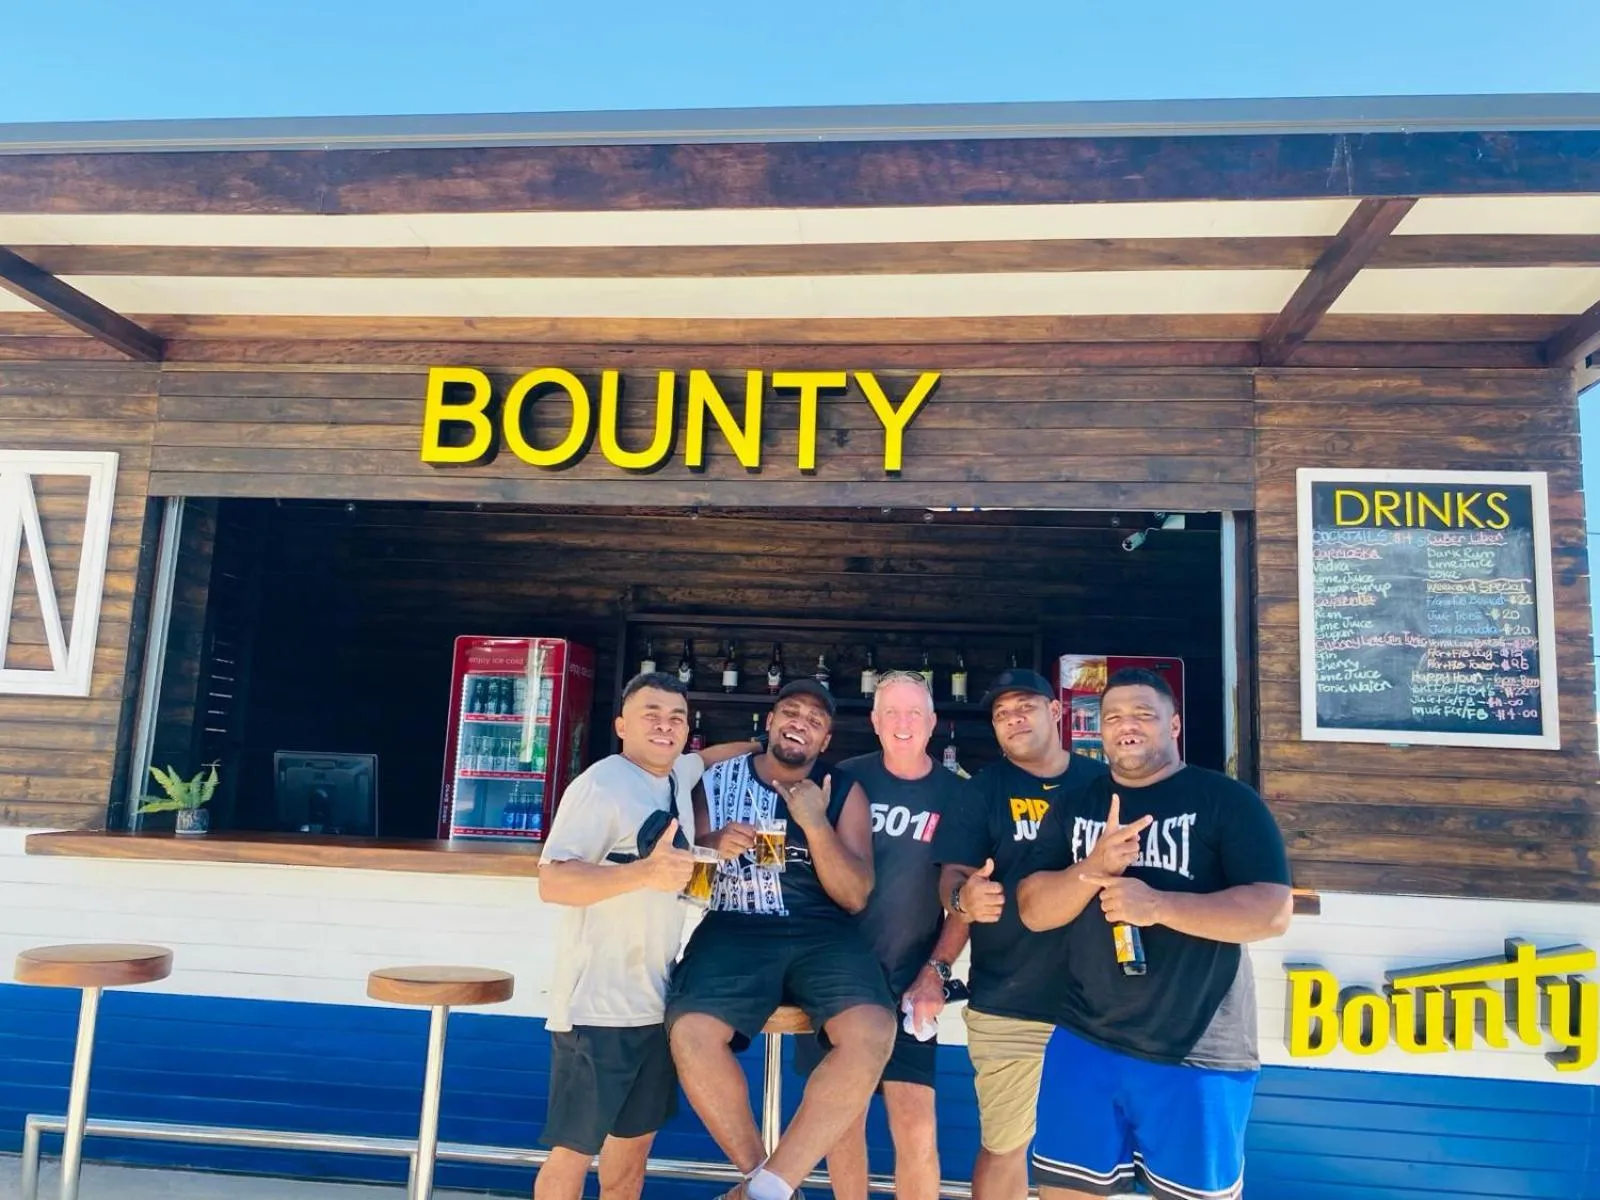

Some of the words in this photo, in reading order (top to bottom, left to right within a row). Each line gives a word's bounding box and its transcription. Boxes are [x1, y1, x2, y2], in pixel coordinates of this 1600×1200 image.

[420, 366, 942, 472] BOUNTY
[1334, 489, 1510, 530] DRINKS
[1463, 547, 1496, 559] Rum
[1342, 571, 1374, 585] Juice
[1342, 616, 1374, 629] Juice
[505, 656, 524, 665] cold
[1344, 669, 1382, 681] Juice
[870, 802, 931, 842] 501
[1284, 940, 1599, 1073] Bounty
